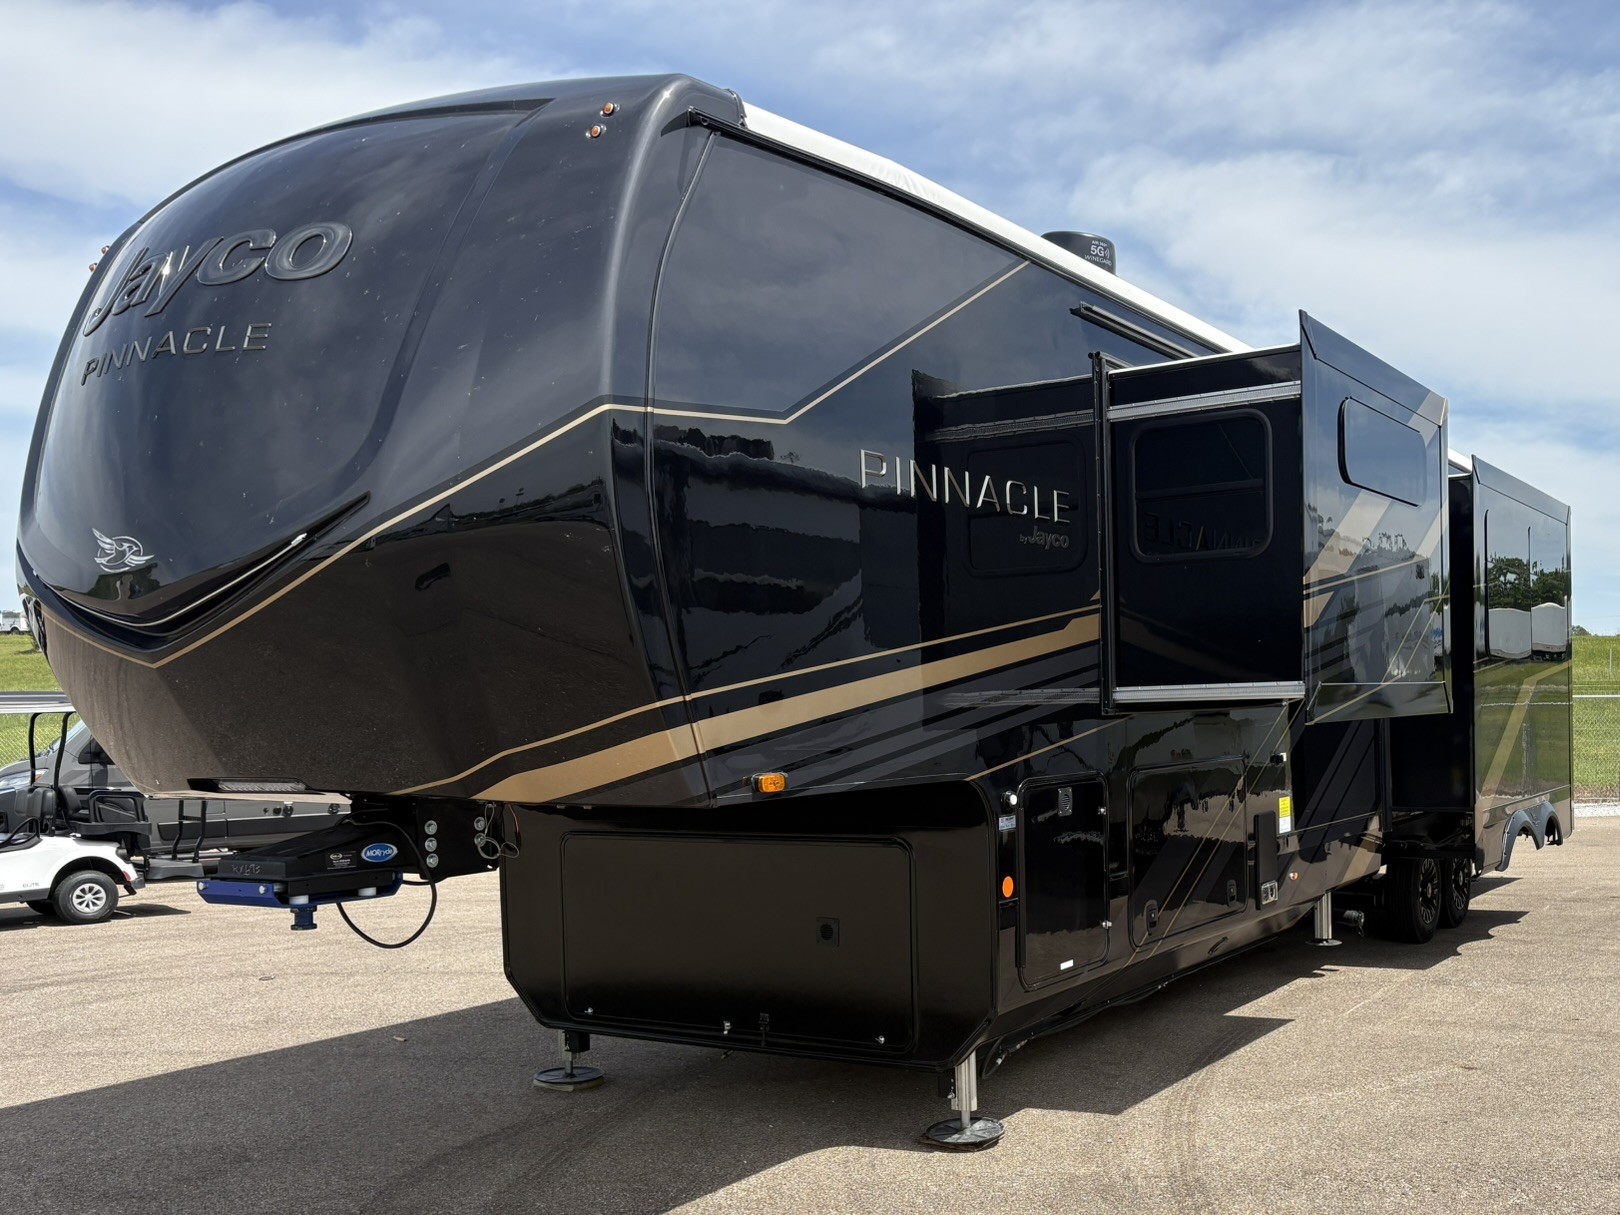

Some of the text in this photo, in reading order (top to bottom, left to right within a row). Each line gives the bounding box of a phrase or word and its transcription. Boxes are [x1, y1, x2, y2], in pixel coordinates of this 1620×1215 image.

[1085, 255, 1112, 266] WINEGARD
[1090, 245, 1104, 257] 5G
[80, 322, 272, 386] PINNACLE
[860, 449, 1071, 523] PINNACLE
[1028, 525, 1070, 549] Jayco
